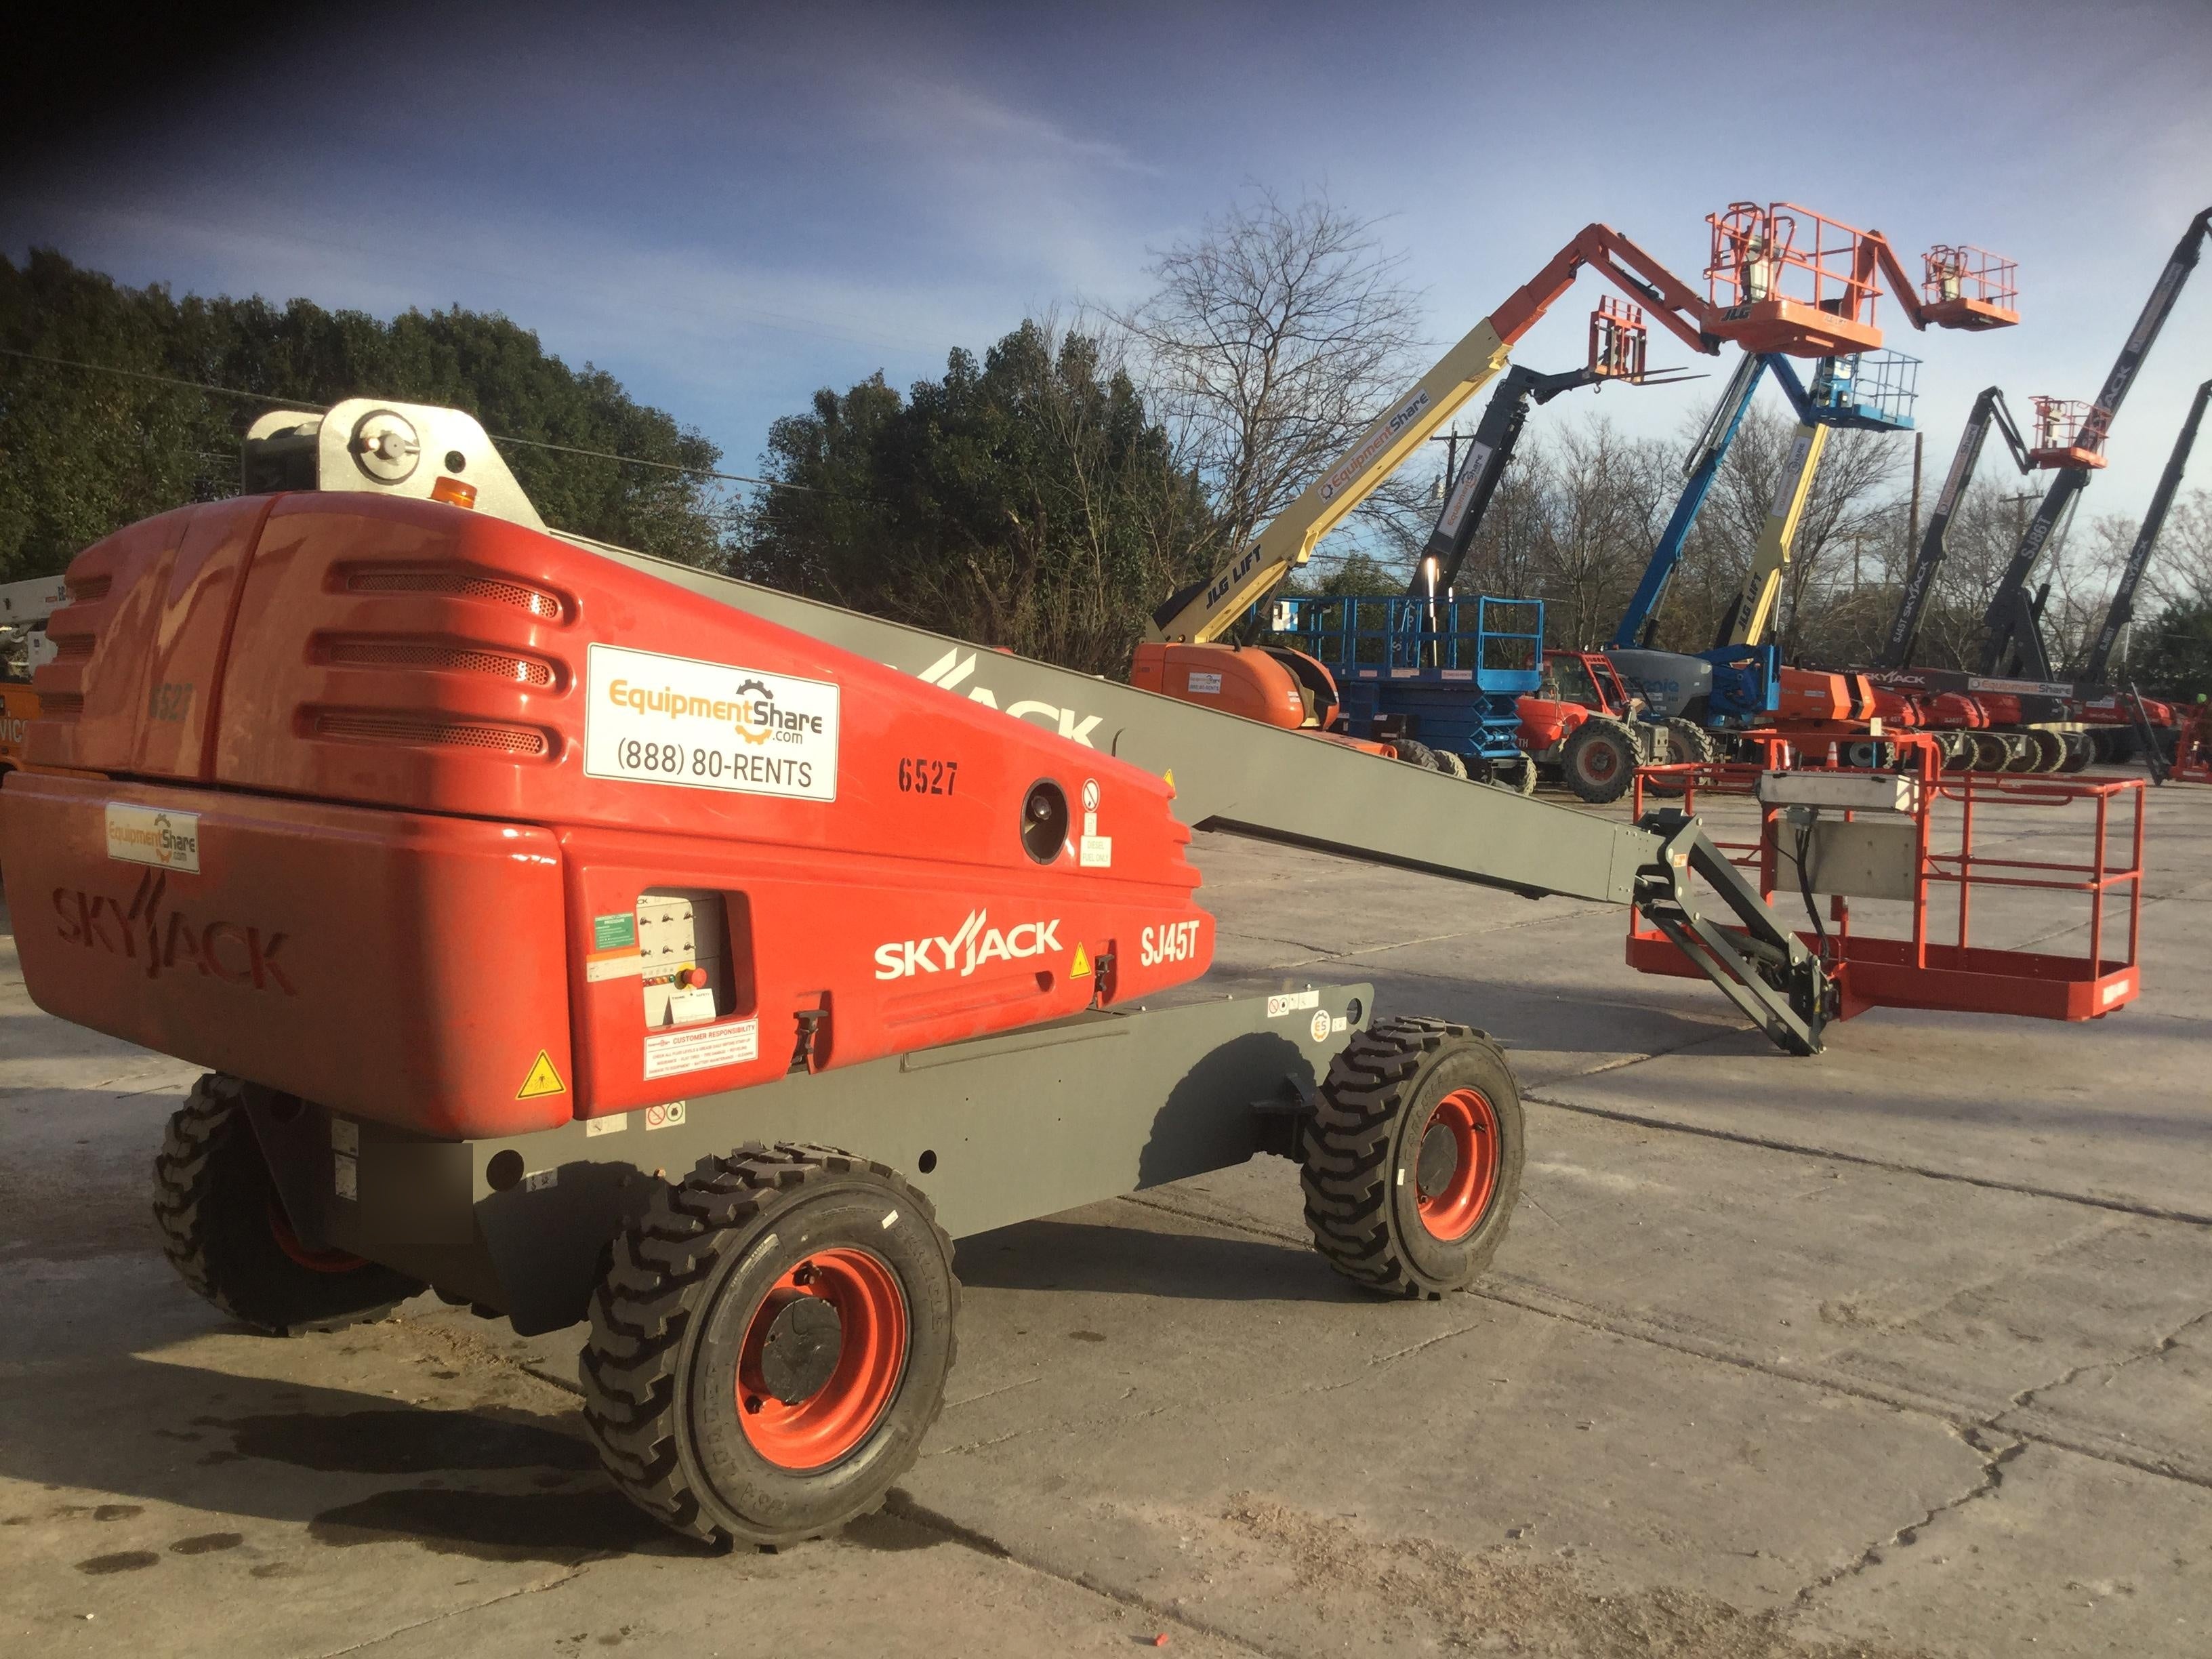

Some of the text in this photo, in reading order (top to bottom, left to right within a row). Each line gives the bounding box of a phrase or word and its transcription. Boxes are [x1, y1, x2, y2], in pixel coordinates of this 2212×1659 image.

[1720, 307, 1752, 321] JLG
[1332, 392, 1429, 487] EquipmentShare
[1447, 453, 1483, 526] EquipmentShare
[2021, 515, 2051, 559] SJ86T
[1206, 544, 1261, 610] JLG LIFT
[1738, 571, 1762, 632] JLG LIFT
[1893, 560, 1929, 643] SJ45T SKYJACK
[610, 679, 822, 734] EquipmentShare
[1982, 680, 2072, 695] EquipmentShare
[773, 729, 802, 744] .com
[618, 737, 813, 787] (888) 80-RENTS
[899, 758, 957, 796] 6527
[108, 821, 196, 853] EquipmentShare
[1082, 853, 1109, 862] FUEL ONLY
[1087, 840, 1104, 850] DIESEL
[52, 867, 298, 997] SKYJACK
[874, 907, 1063, 980] SKYJACK
[1141, 920, 1200, 967] SJ45T
[673, 1032, 707, 1044] CUSTOMER
[708, 1025, 755, 1038] RESPONSIBILITY
